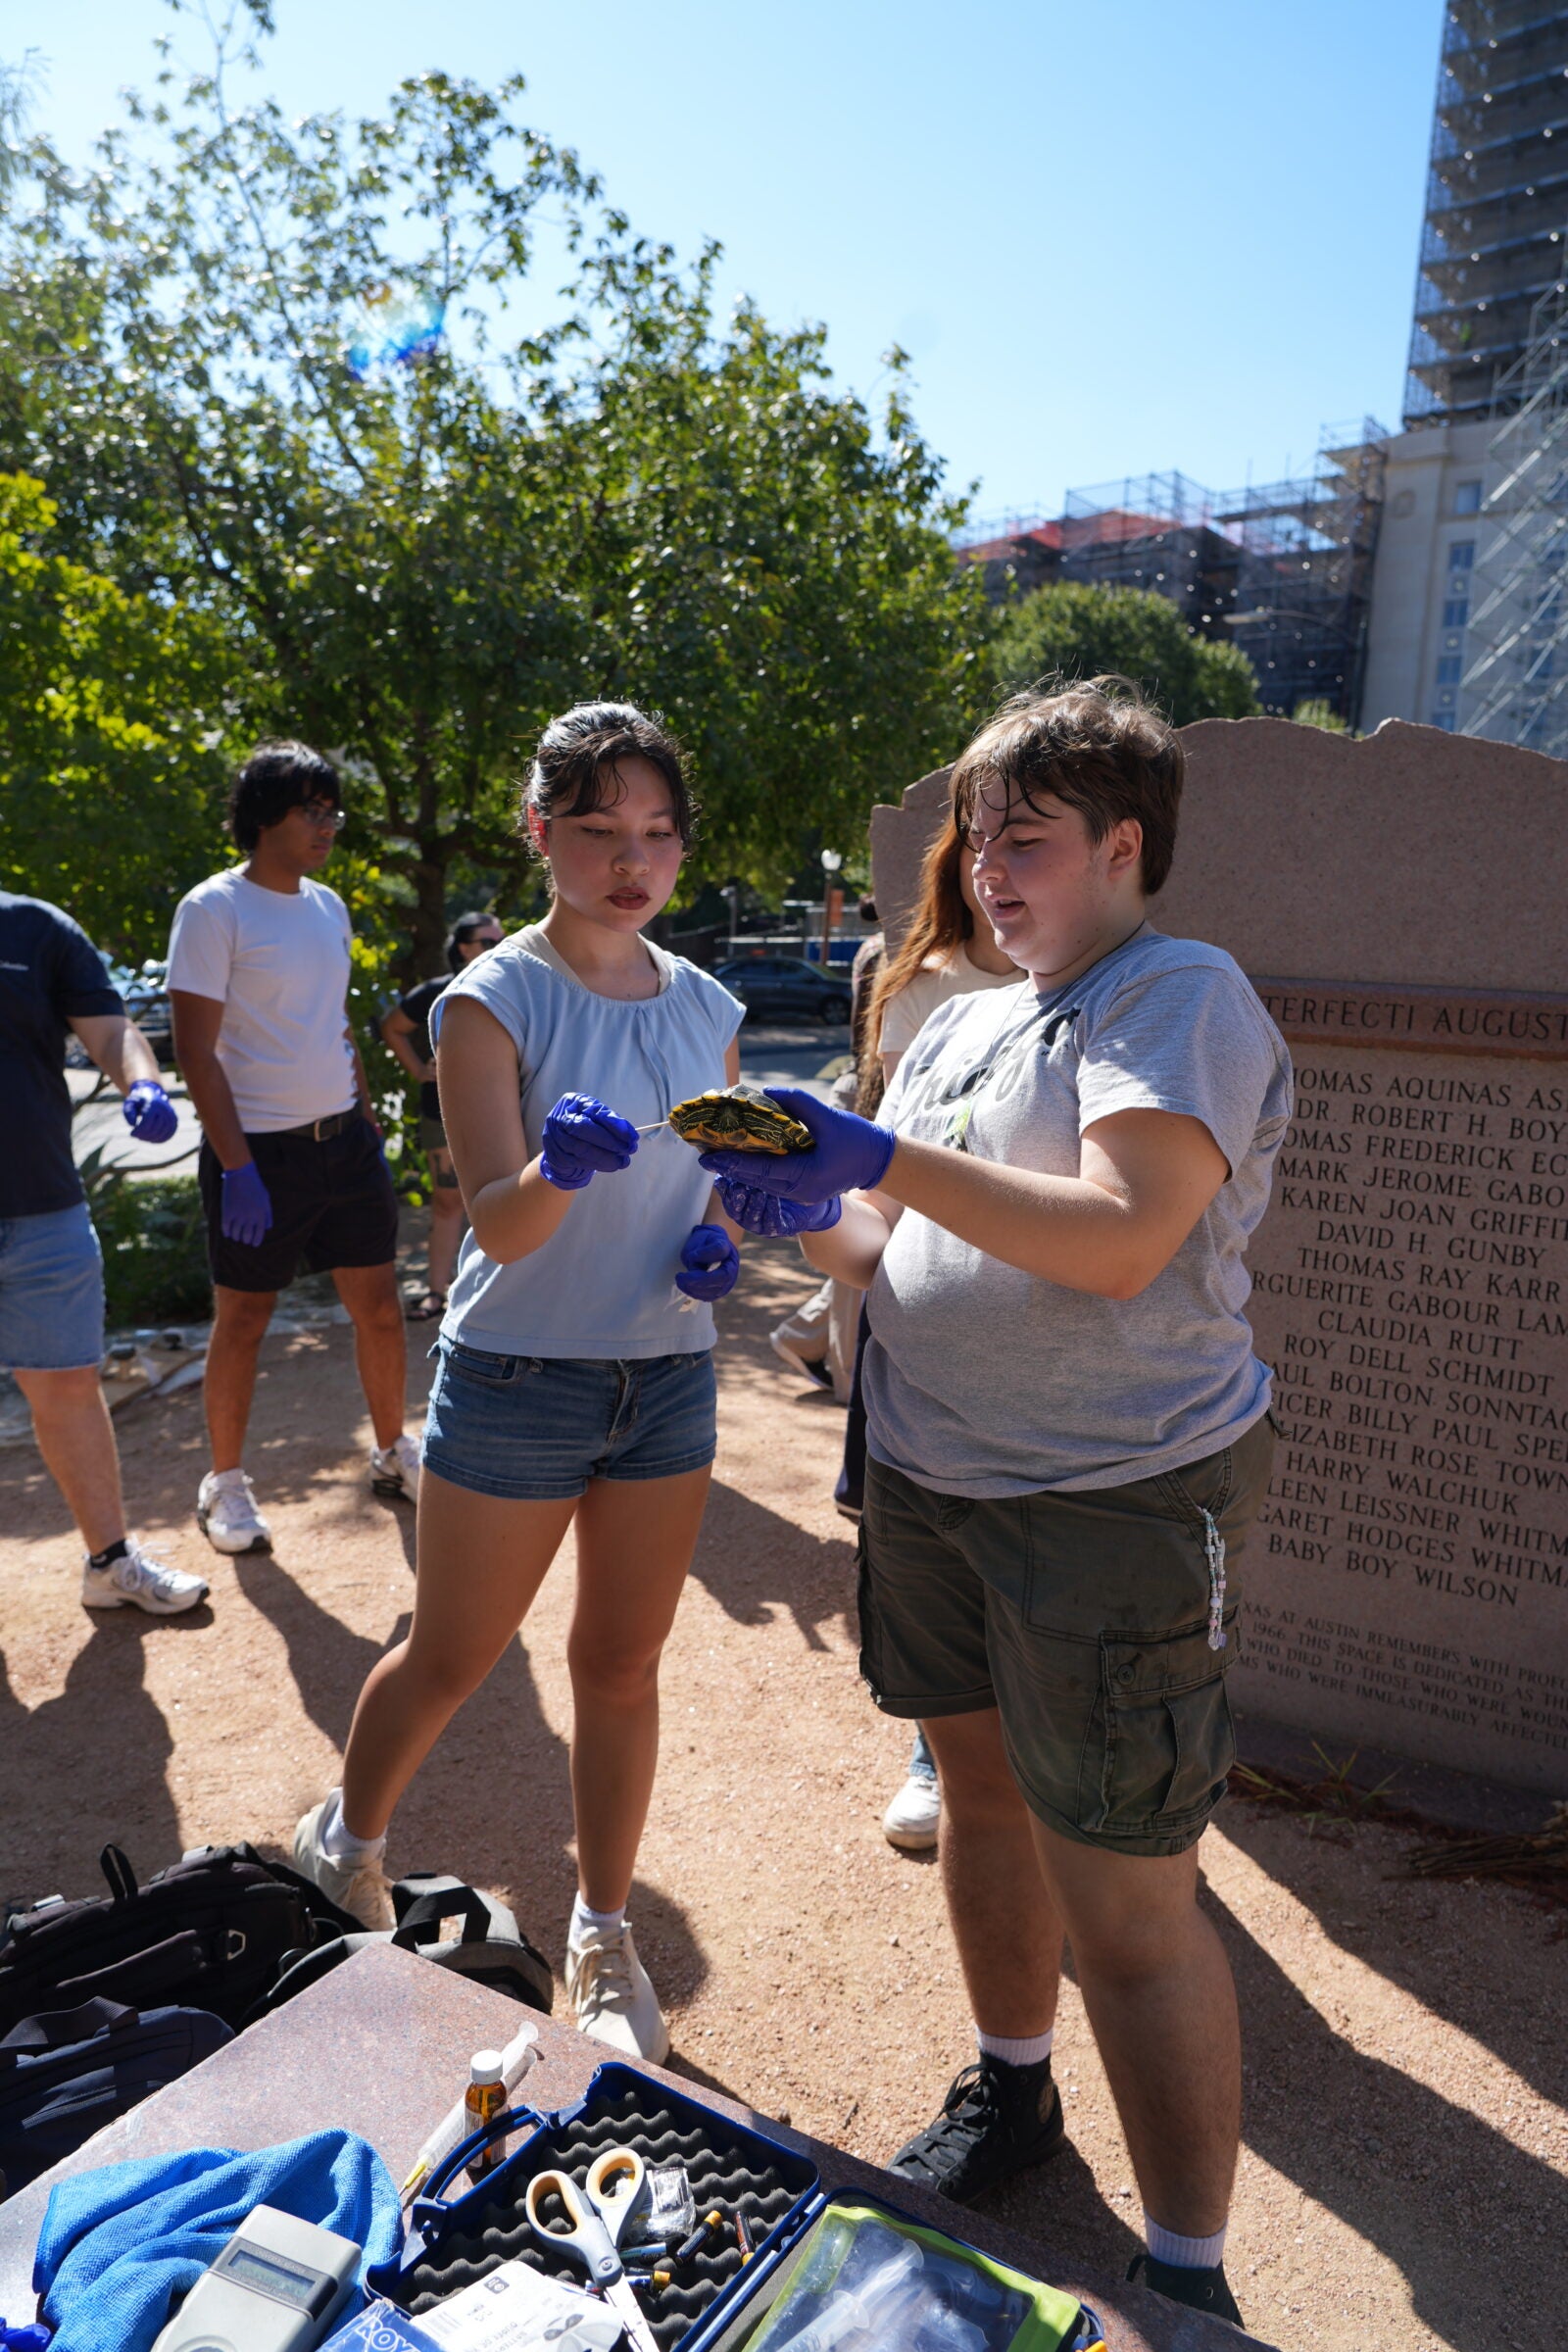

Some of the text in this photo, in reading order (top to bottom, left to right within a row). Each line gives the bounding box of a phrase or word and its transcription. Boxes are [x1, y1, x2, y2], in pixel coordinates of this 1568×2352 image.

[1297, 1098, 1568, 1144] DR. ROBERT H. BOY
[1386, 1076, 1512, 1108] AQUINAS
[1526, 1088, 1568, 1113] AS
[1278, 1156, 1566, 1209] MARK JEROME GABO
[1366, 1136, 1515, 1172] FREDERICK
[1531, 1151, 1568, 1177] EC
[1281, 1187, 1367, 1216] KAREN
[1380, 1199, 1456, 1227] JOAN
[1316, 1220, 1547, 1269] DAVID H. GUNBY
[1298, 1248, 1561, 1304] THOMAS RAY KARR
[1318, 1310, 1524, 1360] CLAUDIA RUTT
[1388, 1290, 1500, 1327] GABOUR
[1284, 1333, 1555, 1397] ROY DELL SCHMIDT
[1329, 1370, 1434, 1407] BOLTON
[1271, 1387, 1568, 1464] ICER BILLY PAUL SPE
[1286, 1450, 1519, 1516] HARRY WALCHUK
[1411, 1445, 1478, 1478] ROSE
[1341, 1490, 1461, 1535] LEISSNER
[1267, 1533, 1519, 1607] BABY BOY WILSON
[1346, 1520, 1455, 1563] HODGES
[1471, 1546, 1568, 1588] WHITM
[1278, 1610, 1297, 1625] AT
[1303, 1617, 1360, 1640] AUSTIN
[1367, 1631, 1460, 1664] REMEMBERS
[1468, 1654, 1510, 1678] WITH
[1297, 1631, 1331, 1652] THIS
[1337, 1642, 1386, 1666] SPACE
[1392, 1655, 1406, 1671] IS
[1413, 1660, 1505, 1695] DEDICATED
[1512, 1686, 1535, 1703] AS
[1246, 1637, 1280, 1656] WHO
[1287, 1648, 1322, 1668] DIED
[1333, 1658, 1353, 1676] TO
[1361, 1665, 1411, 1690] THOSE
[1420, 1680, 1457, 1703] WHO
[1466, 1692, 1510, 1716] WERE
[1266, 1659, 1300, 1681] WHO
[1308, 1670, 1348, 1693] WERE
[1356, 1684, 1480, 1727] IMMEASURABLY
